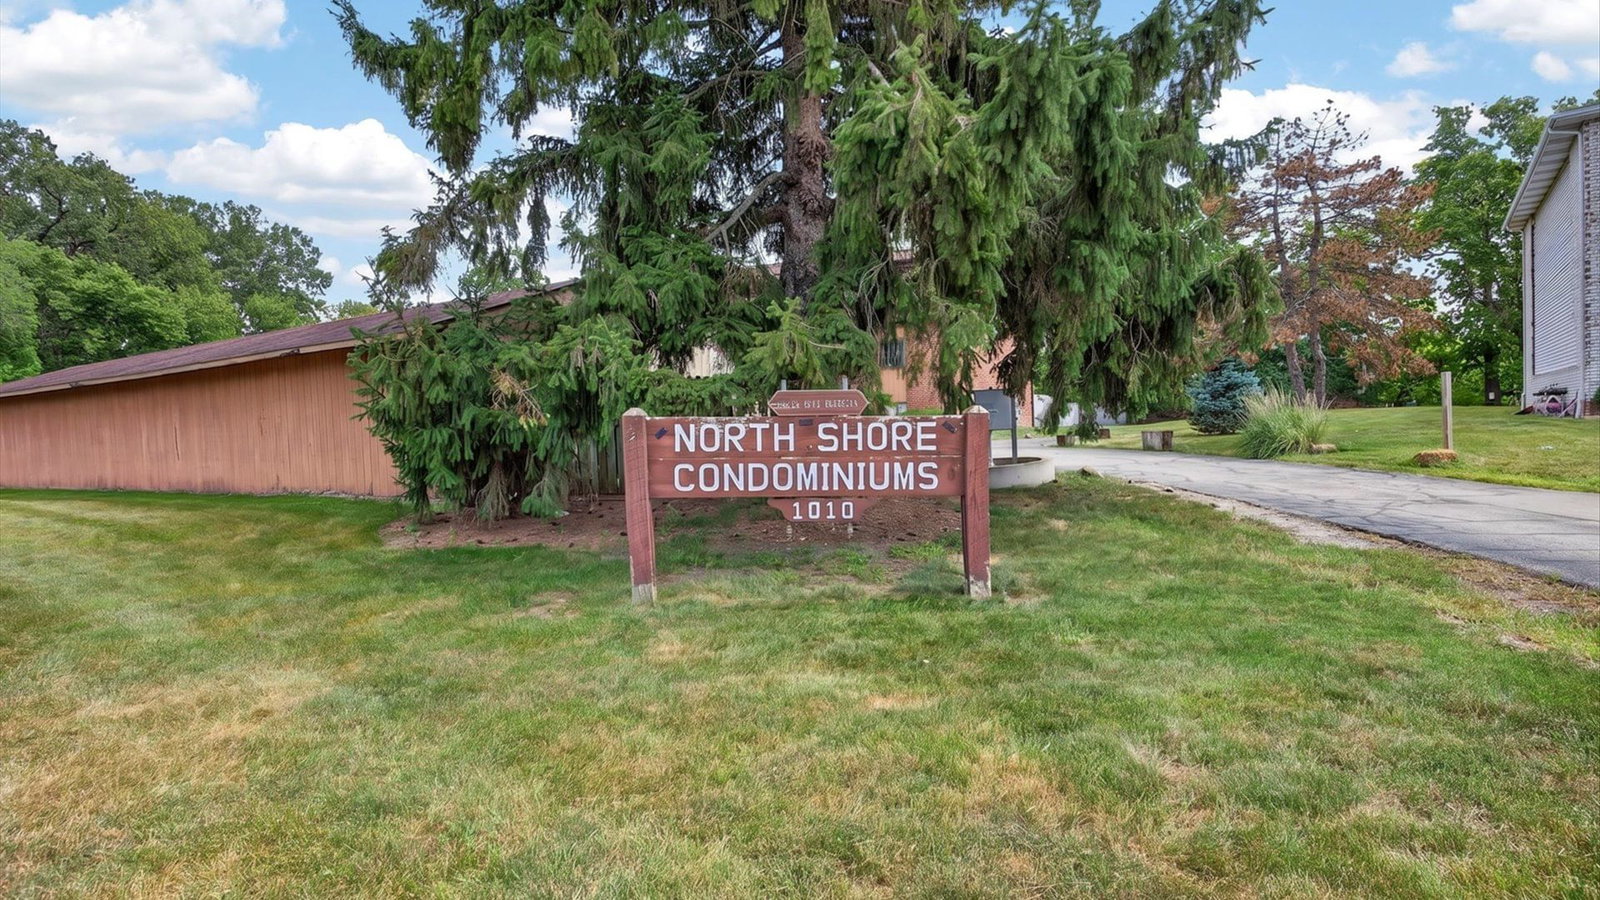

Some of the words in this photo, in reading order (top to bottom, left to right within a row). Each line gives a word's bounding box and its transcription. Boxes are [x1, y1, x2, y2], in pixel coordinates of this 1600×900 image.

[674, 423, 795, 452] NORTH
[817, 421, 938, 451] SHORE
[673, 462, 939, 492] CONDOMINIUMS
[792, 501, 854, 520] 1010
